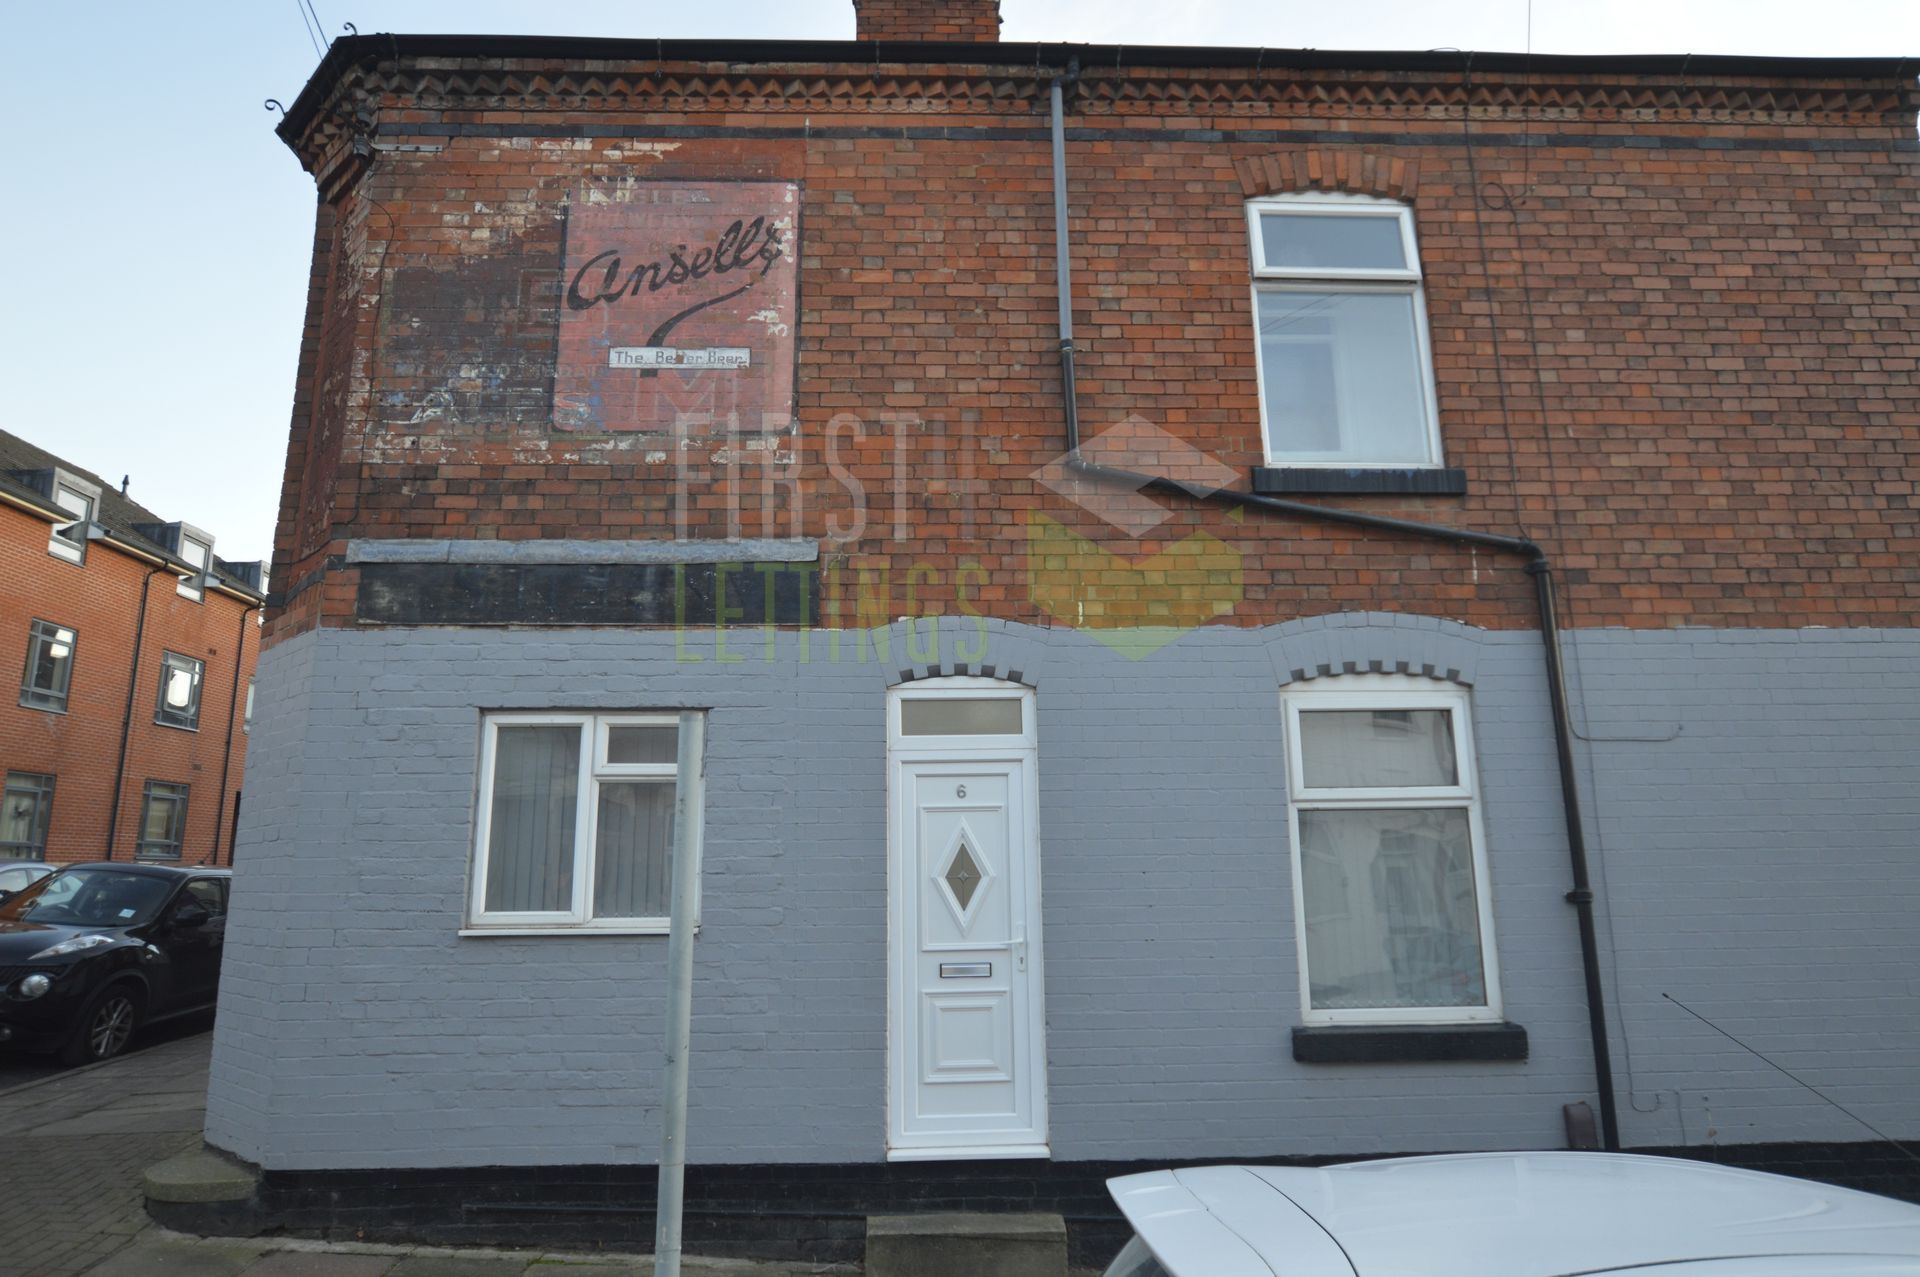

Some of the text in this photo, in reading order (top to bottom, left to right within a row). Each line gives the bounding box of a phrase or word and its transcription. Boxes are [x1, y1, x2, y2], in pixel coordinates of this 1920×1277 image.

[614, 350, 645, 364] The
[655, 350, 703, 365] Beer
[956, 784, 967, 799] 6
